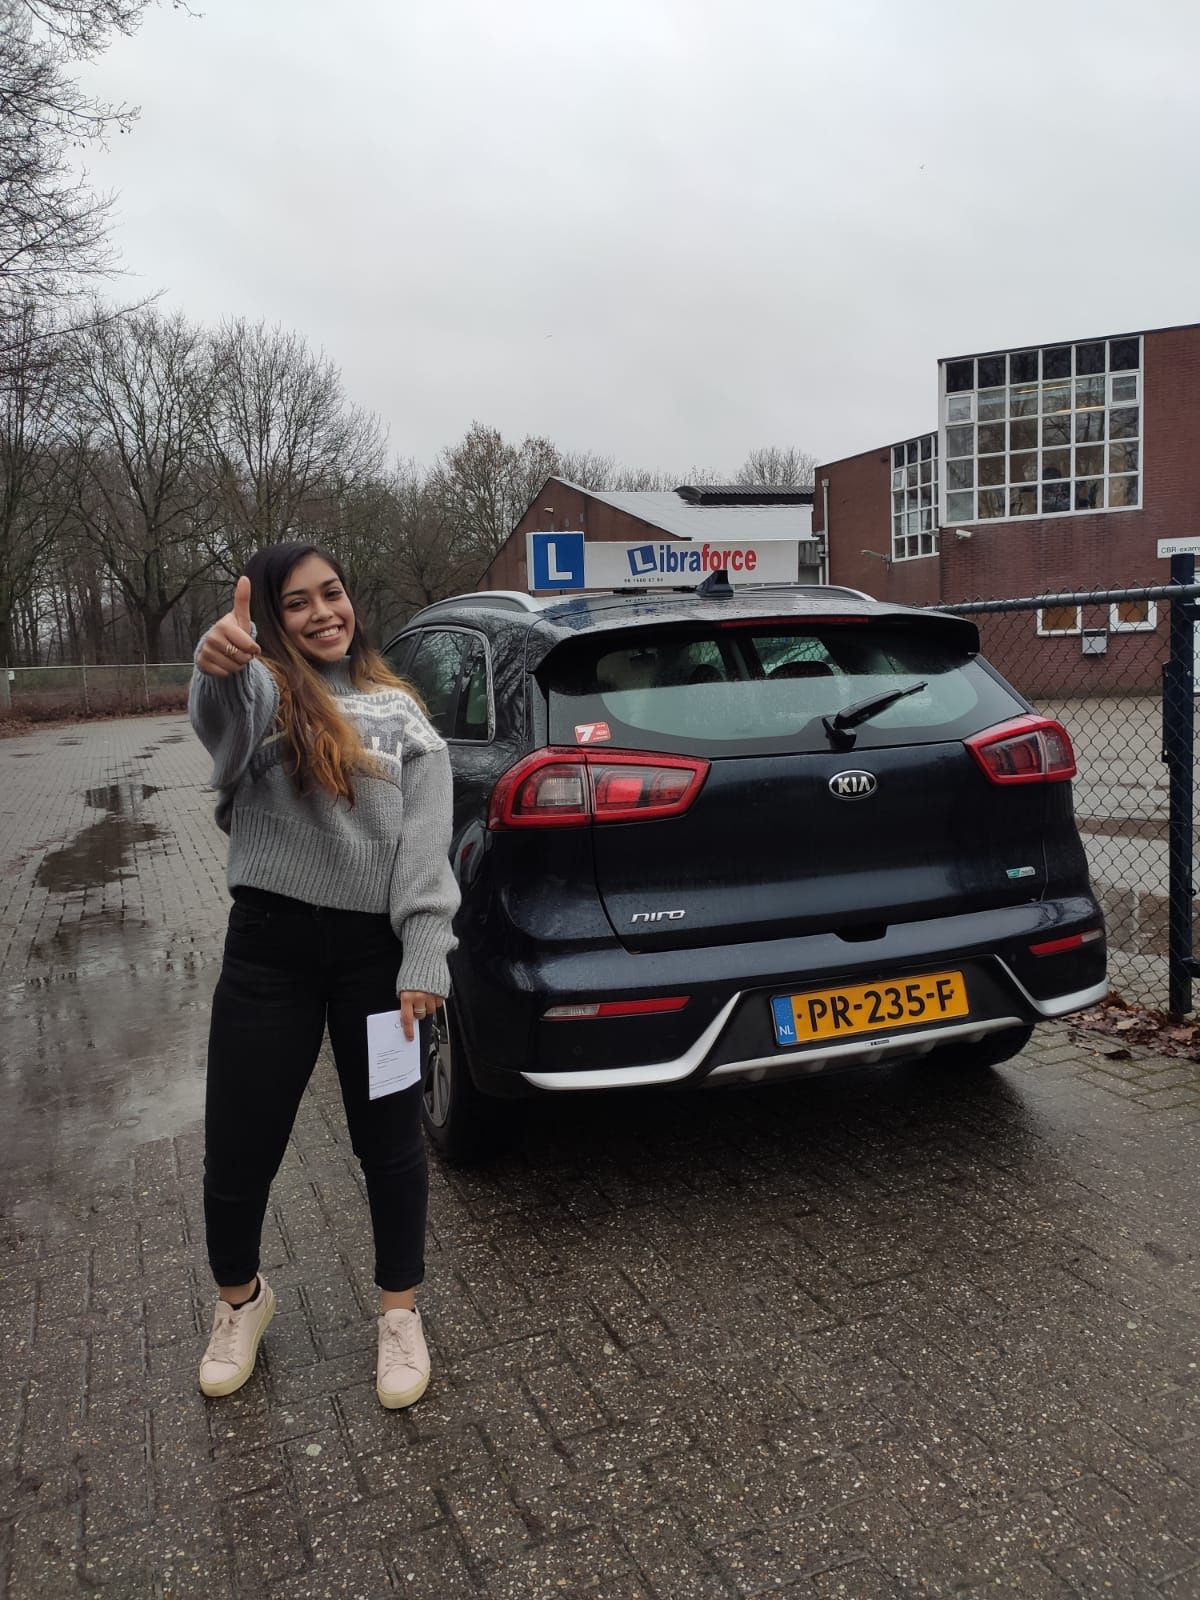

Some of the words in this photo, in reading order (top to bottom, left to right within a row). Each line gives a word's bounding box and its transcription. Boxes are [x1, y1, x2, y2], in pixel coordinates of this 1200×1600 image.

[547, 542, 573, 581] L
[627, 543, 757, 576] Libraforce
[837, 775, 871, 794] KIA
[808, 979, 953, 1033] PR-235-F
[779, 1025, 794, 1036] NL
